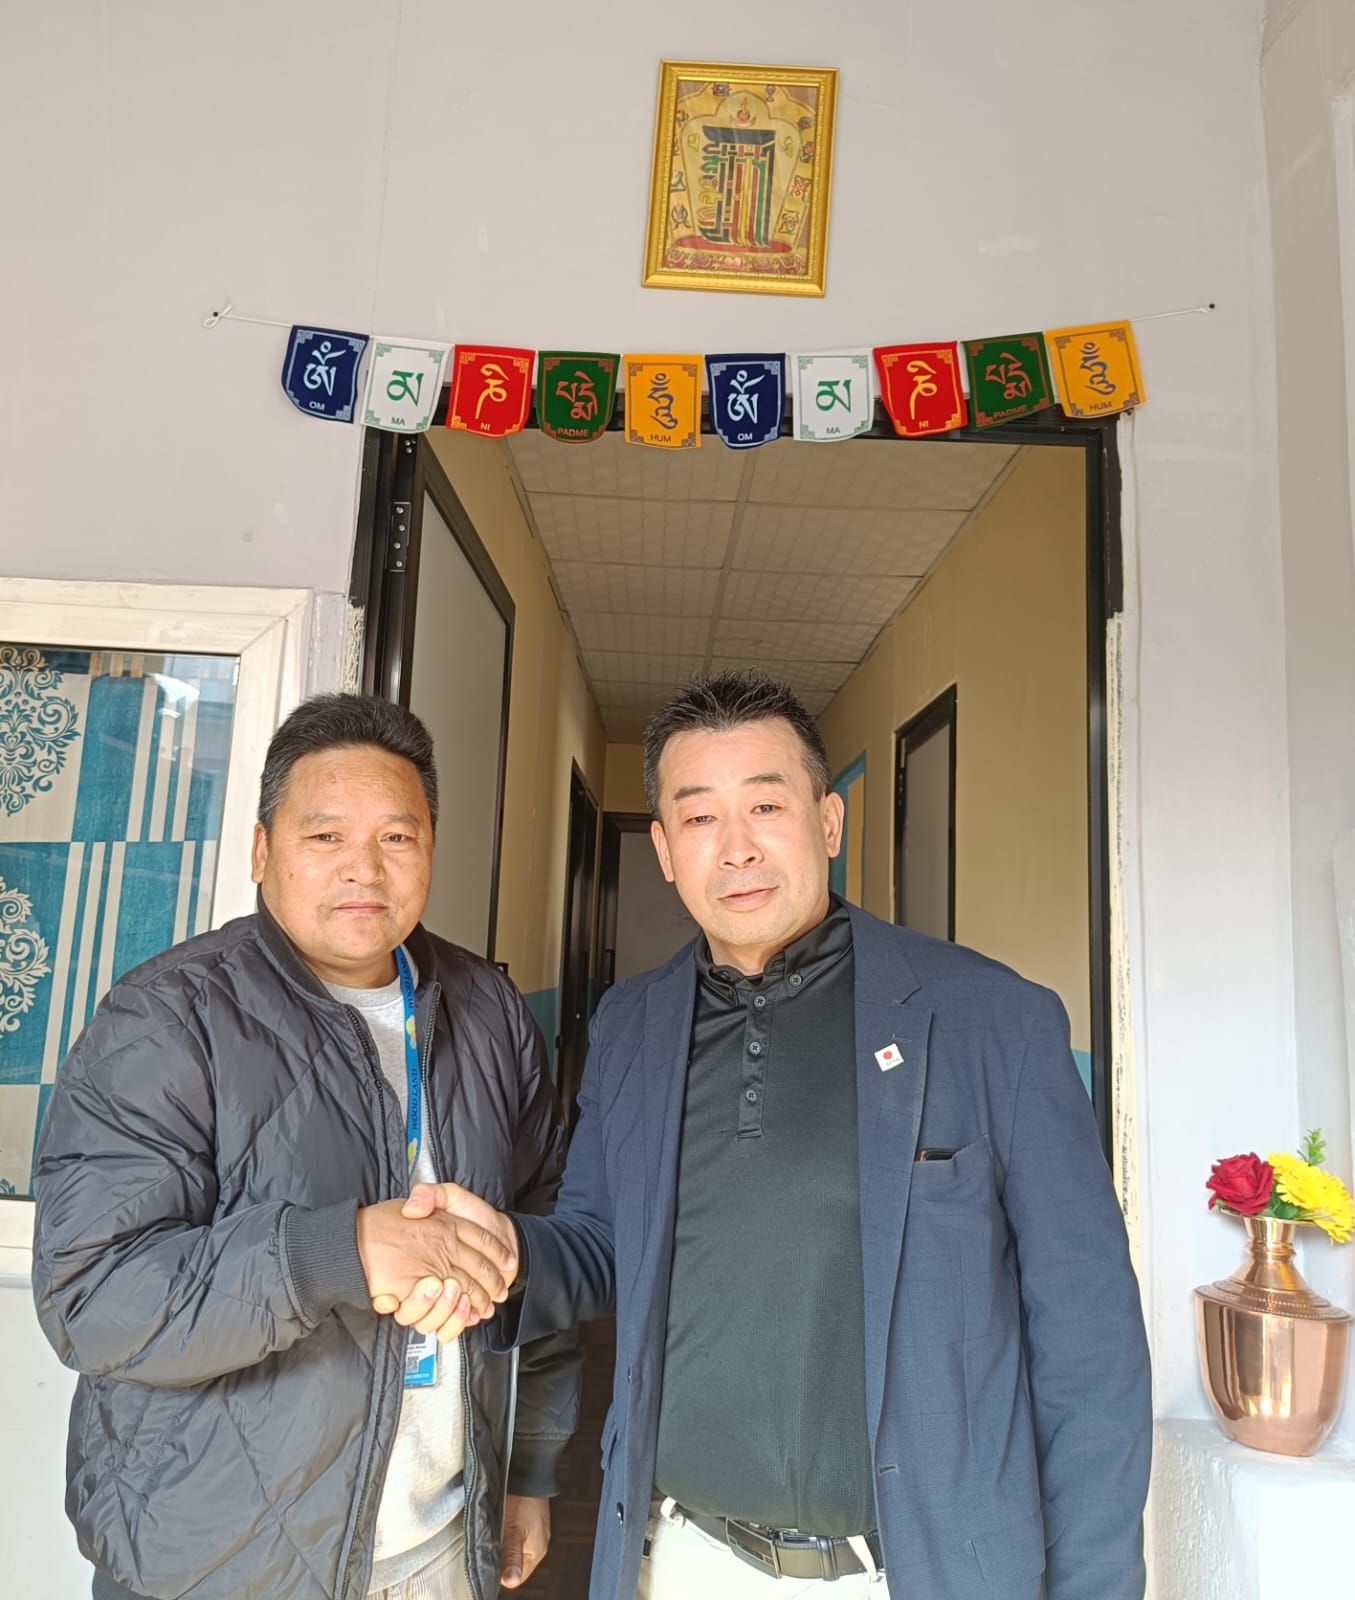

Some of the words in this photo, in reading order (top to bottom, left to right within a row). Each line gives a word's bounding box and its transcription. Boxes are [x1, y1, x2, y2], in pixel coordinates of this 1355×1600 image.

[309, 401, 325, 410] OM
[1090, 401, 1113, 411] HUM
[993, 405, 1028, 420] PADME
[391, 417, 406, 426] MA
[919, 420, 929, 429] NI
[480, 422, 491, 431] NI
[826, 426, 841, 434] MA
[558, 427, 589, 438] PADME
[737, 432, 753, 441] OM
[650, 433, 672, 443] HUM
[411, 1068, 419, 1096] LAND
[411, 1097, 419, 1131] WOOD
